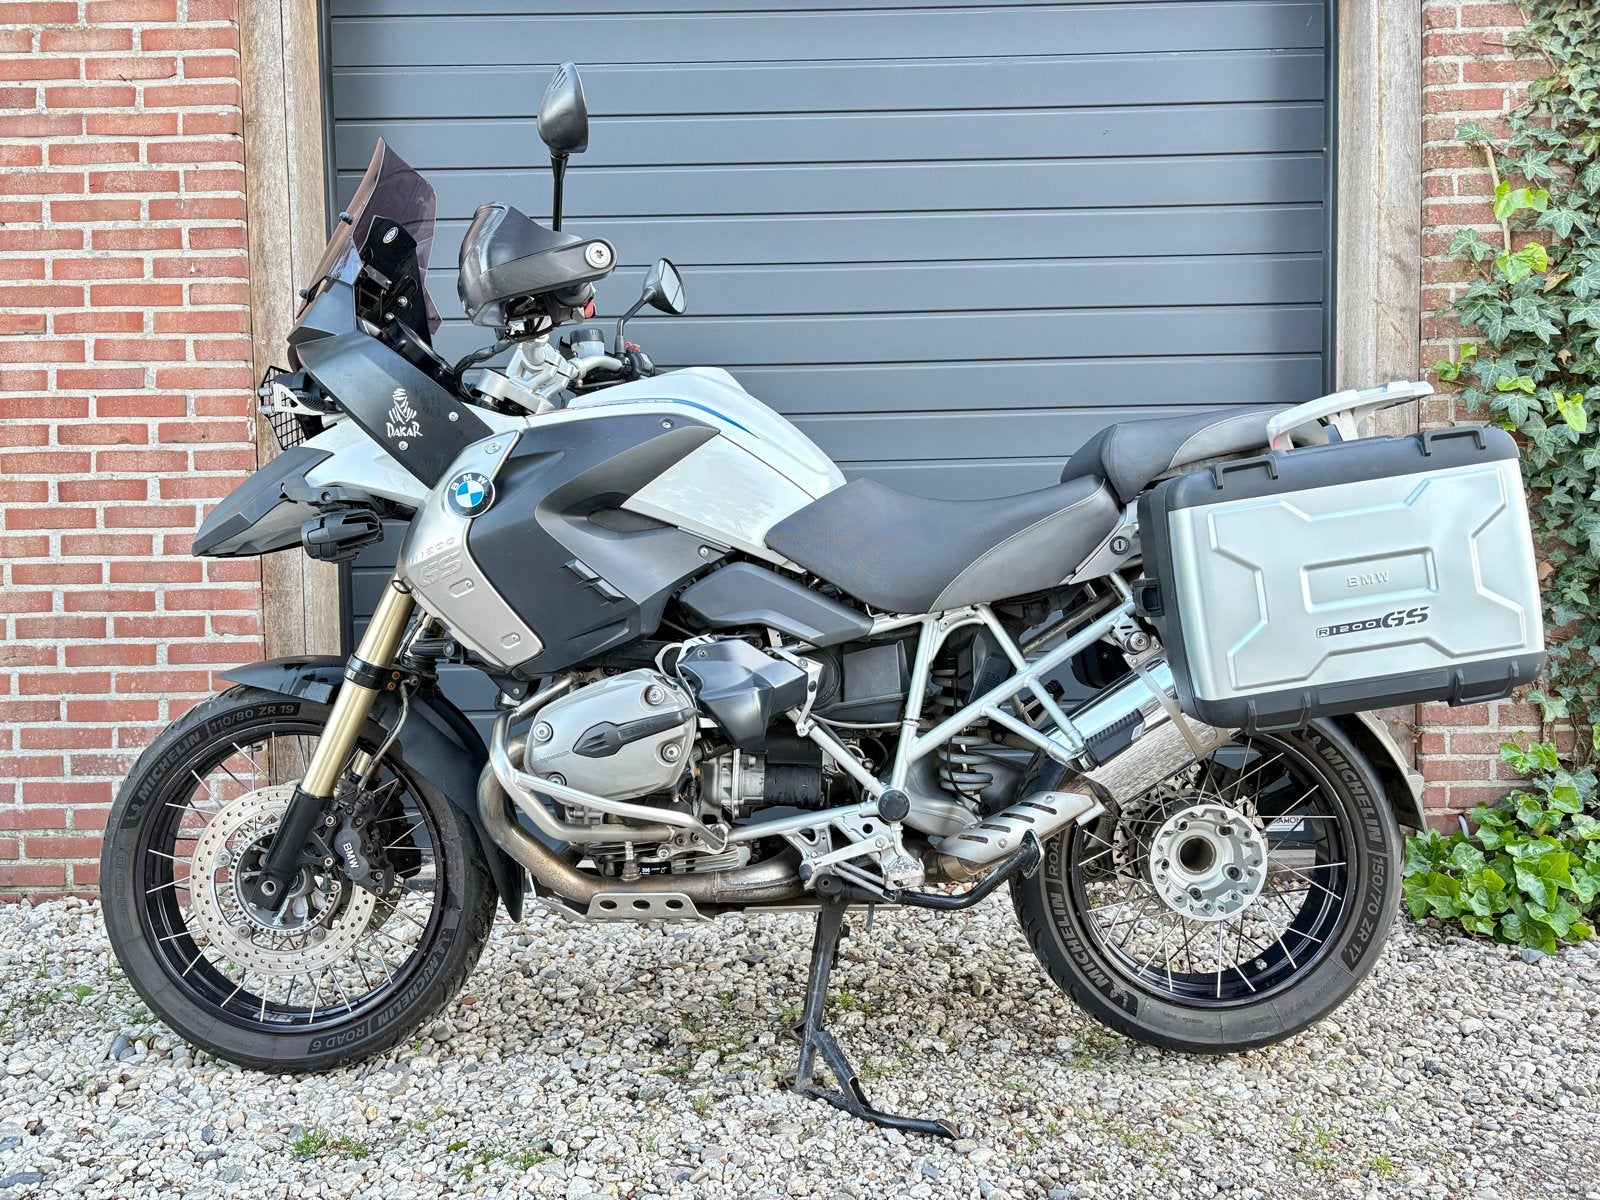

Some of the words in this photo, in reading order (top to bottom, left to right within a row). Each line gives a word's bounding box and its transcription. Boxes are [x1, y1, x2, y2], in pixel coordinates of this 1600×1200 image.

[386, 421, 423, 438] DAKAR
[450, 474, 488, 491] BMW
[417, 550, 463, 587] GS
[1347, 571, 1390, 587] BMW
[138, 731, 202, 802] MICHELIN
[211, 709, 254, 733] 110/80
[258, 704, 276, 716] ZR
[280, 704, 295, 715] 19
[1321, 745, 1383, 844] MICHELIN
[343, 842, 359, 868] BMW
[1367, 857, 1384, 915] 150/70
[1051, 891, 1110, 988] MICHELIN
[1357, 917, 1374, 942] ZR
[1349, 943, 1362, 964] 17
[377, 956, 439, 1025] MICHELIN
[312, 1039, 323, 1051] 6
[325, 1024, 366, 1048] ROAD
